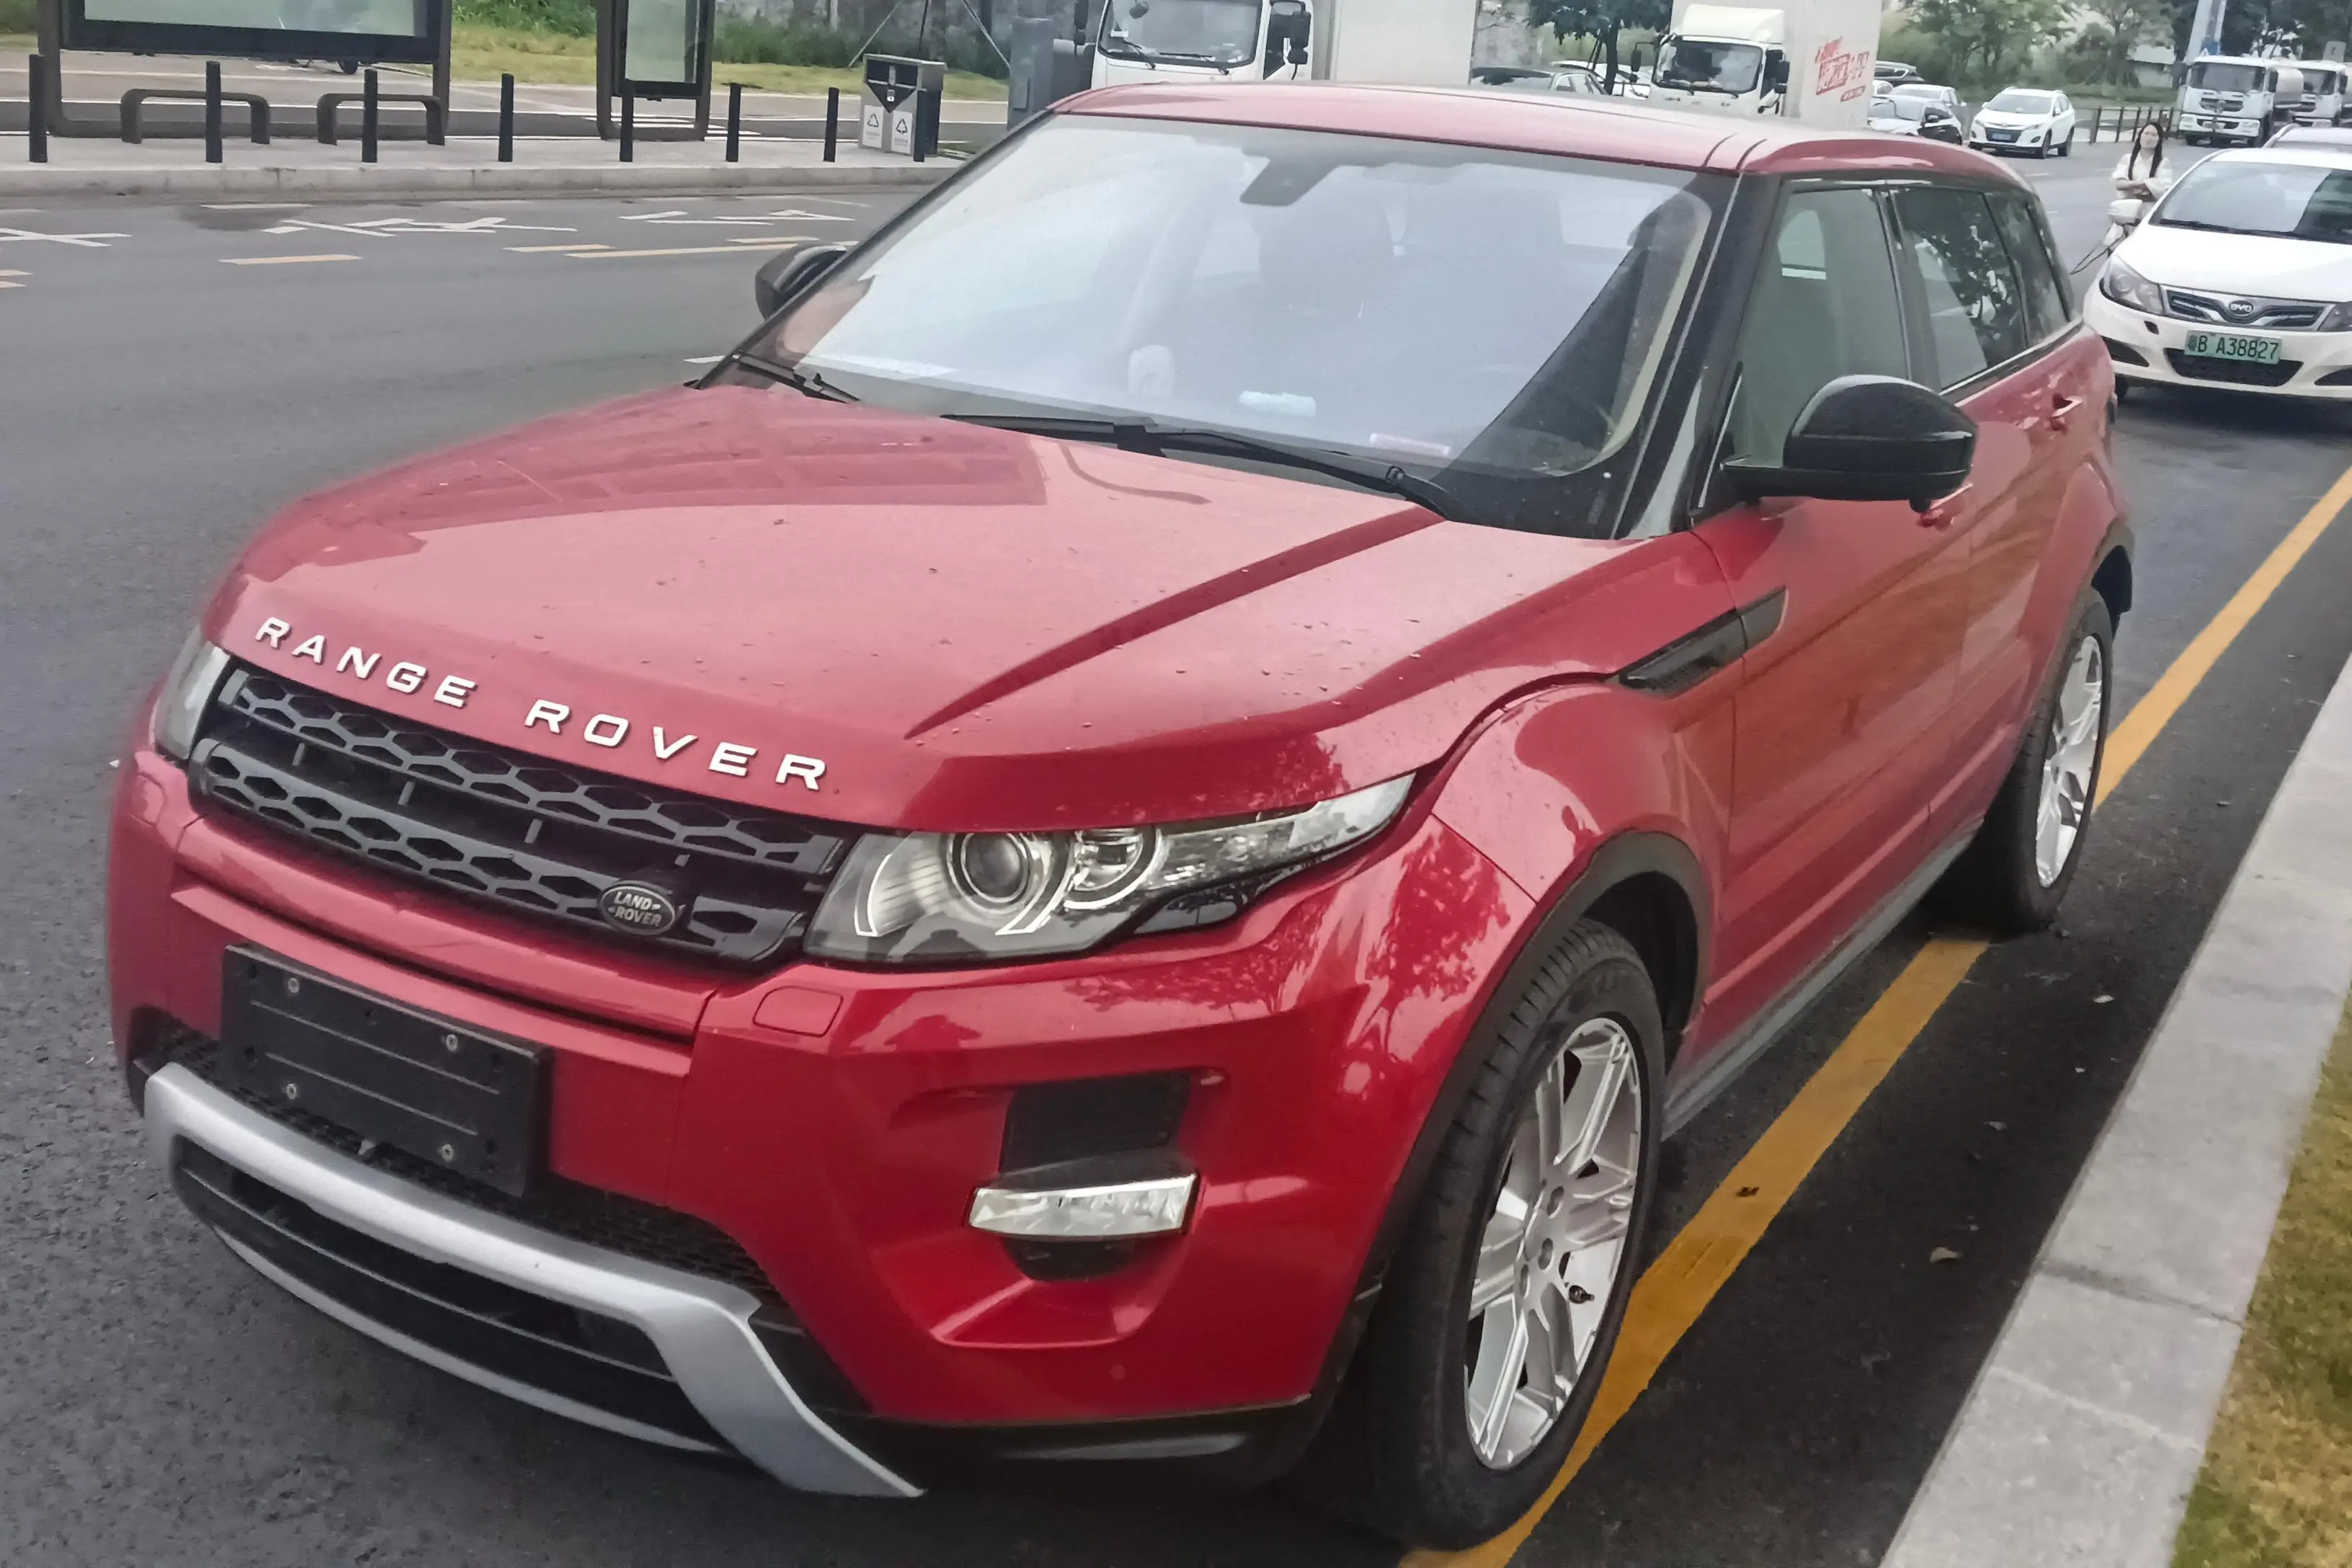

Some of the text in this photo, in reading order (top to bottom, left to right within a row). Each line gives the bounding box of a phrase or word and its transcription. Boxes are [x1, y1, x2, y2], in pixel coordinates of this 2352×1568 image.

[2216, 337, 2279, 360] A38827
[254, 616, 828, 791] RANGE ROVER
[614, 891, 652, 910] LAND
[615, 906, 662, 927] ROVER
